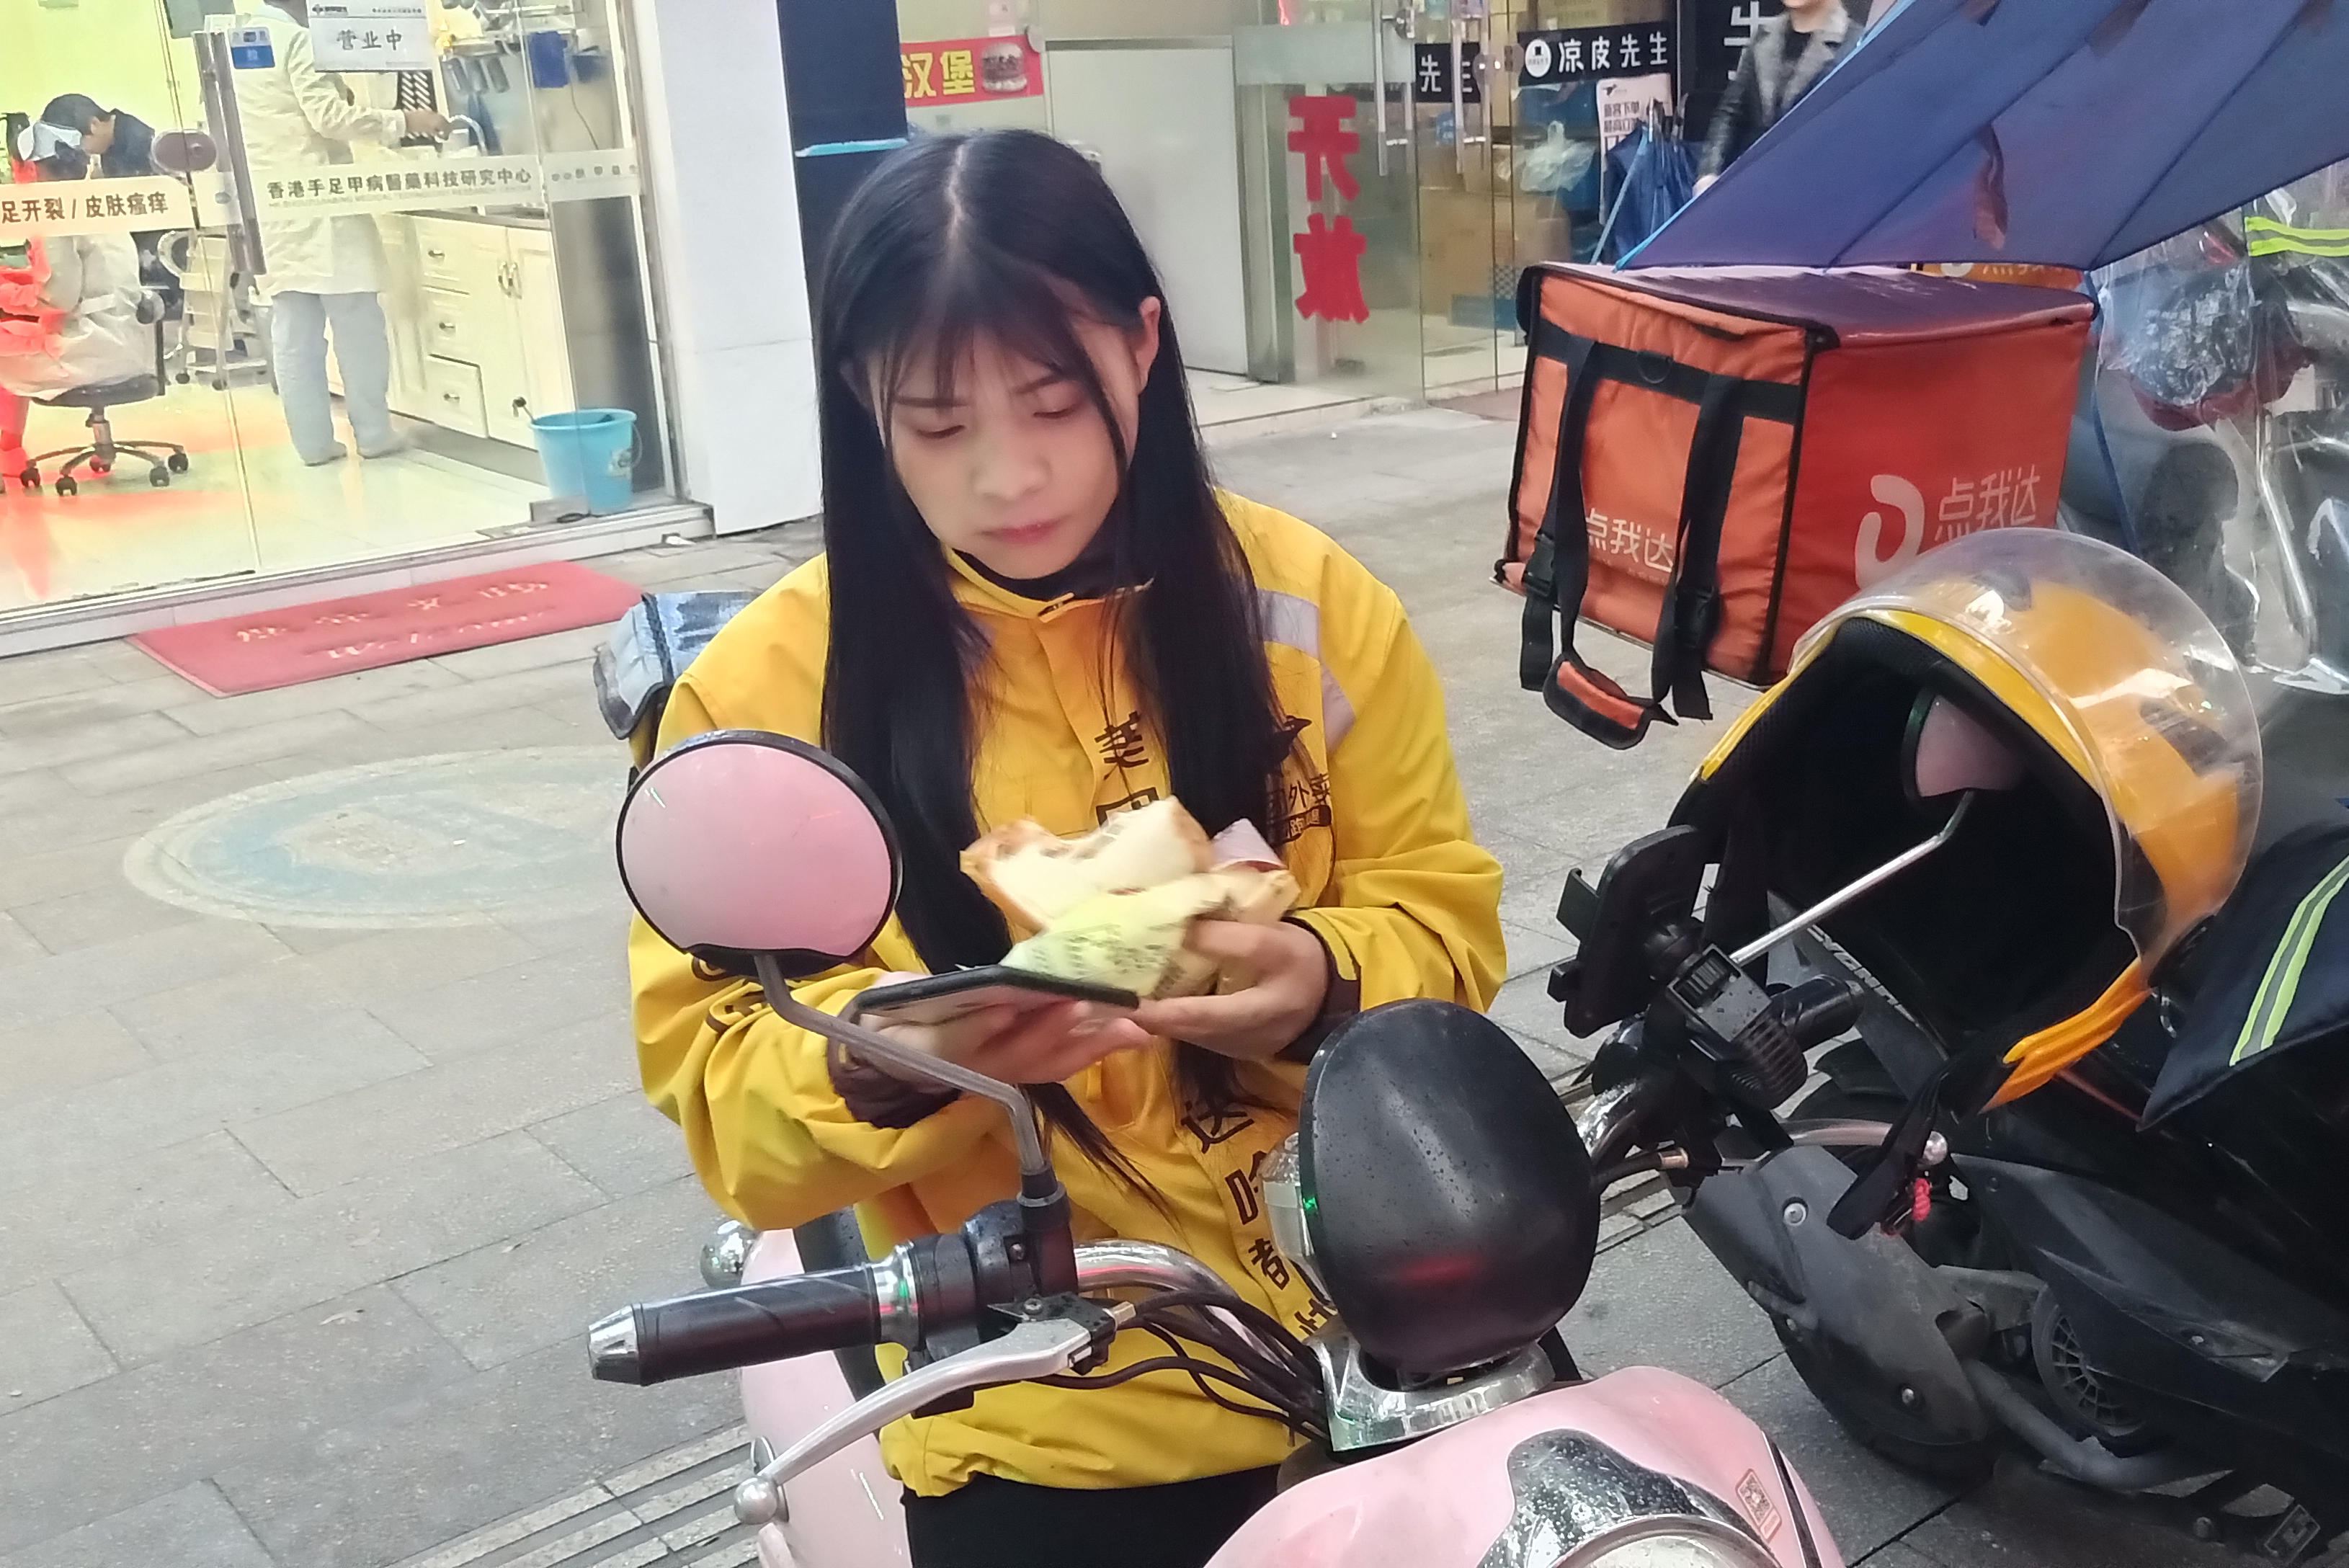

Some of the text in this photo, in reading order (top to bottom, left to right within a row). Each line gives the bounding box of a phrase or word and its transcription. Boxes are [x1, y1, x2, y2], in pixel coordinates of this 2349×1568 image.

[336, 29, 402, 51] 营业中
[1559, 31, 1668, 73] 凉皮先生
[901, 50, 976, 99] 汉堡
[1935, 464, 2041, 541] 点我达
[1585, 508, 1673, 573] 点我达
